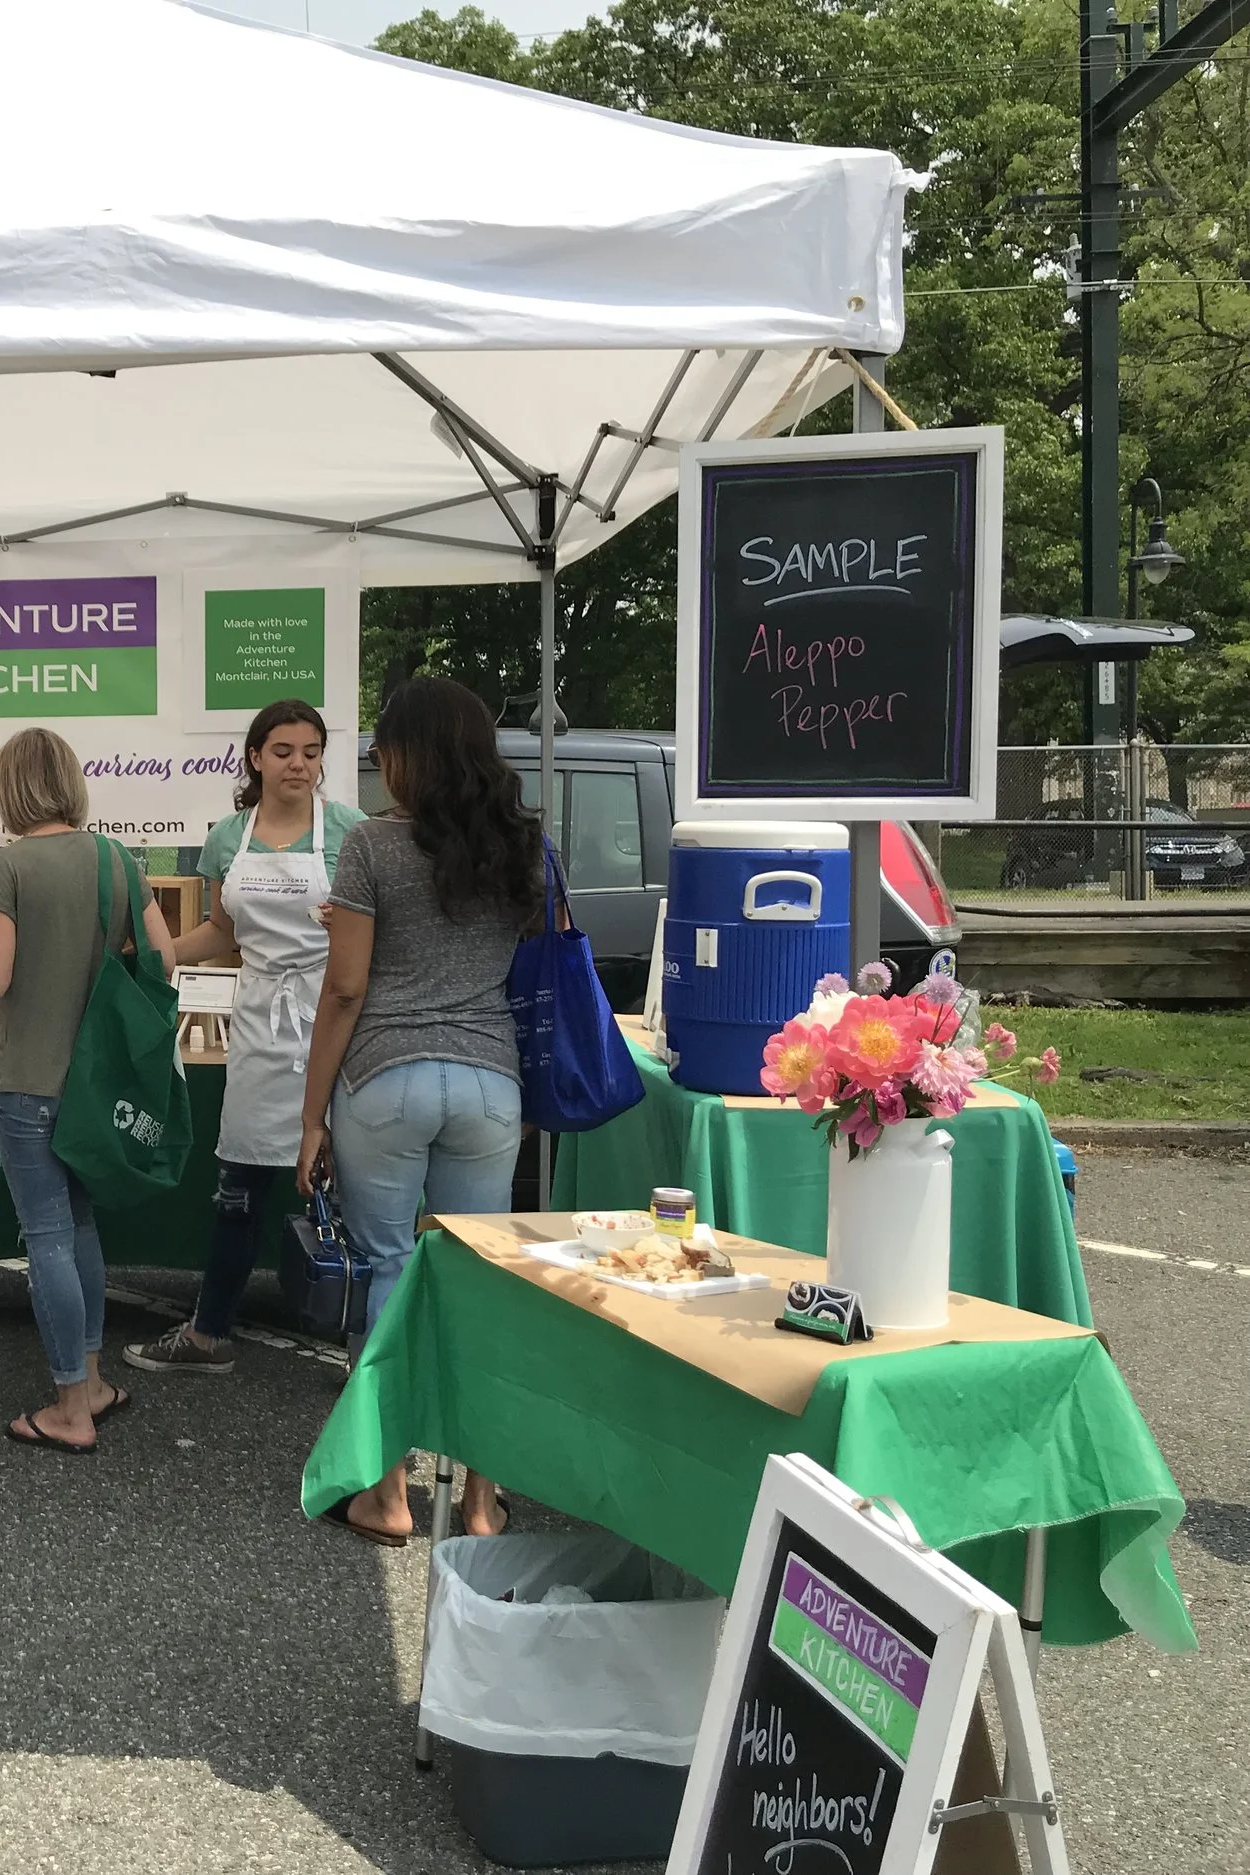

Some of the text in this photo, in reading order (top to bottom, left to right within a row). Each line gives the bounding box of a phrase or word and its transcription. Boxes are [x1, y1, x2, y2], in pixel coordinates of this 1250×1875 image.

[740, 534, 928, 585] SAMPLE
[223, 616, 308, 628] Made with love
[249, 631, 282, 641] in the
[236, 644, 296, 654] Adventure
[244, 657, 287, 668] Kitchen
[742, 624, 865, 687] Aleppo
[215, 669, 316, 682] Montclair, NJ USA
[771, 684, 908, 749] Pepper
[83, 743, 245, 782] curious cooks
[800, 1578, 913, 1687] ADVENTURE
[801, 1628, 895, 1731] KITCHEN
[736, 1699, 797, 1766] Hello
[752, 1767, 887, 1875] neighbors!
